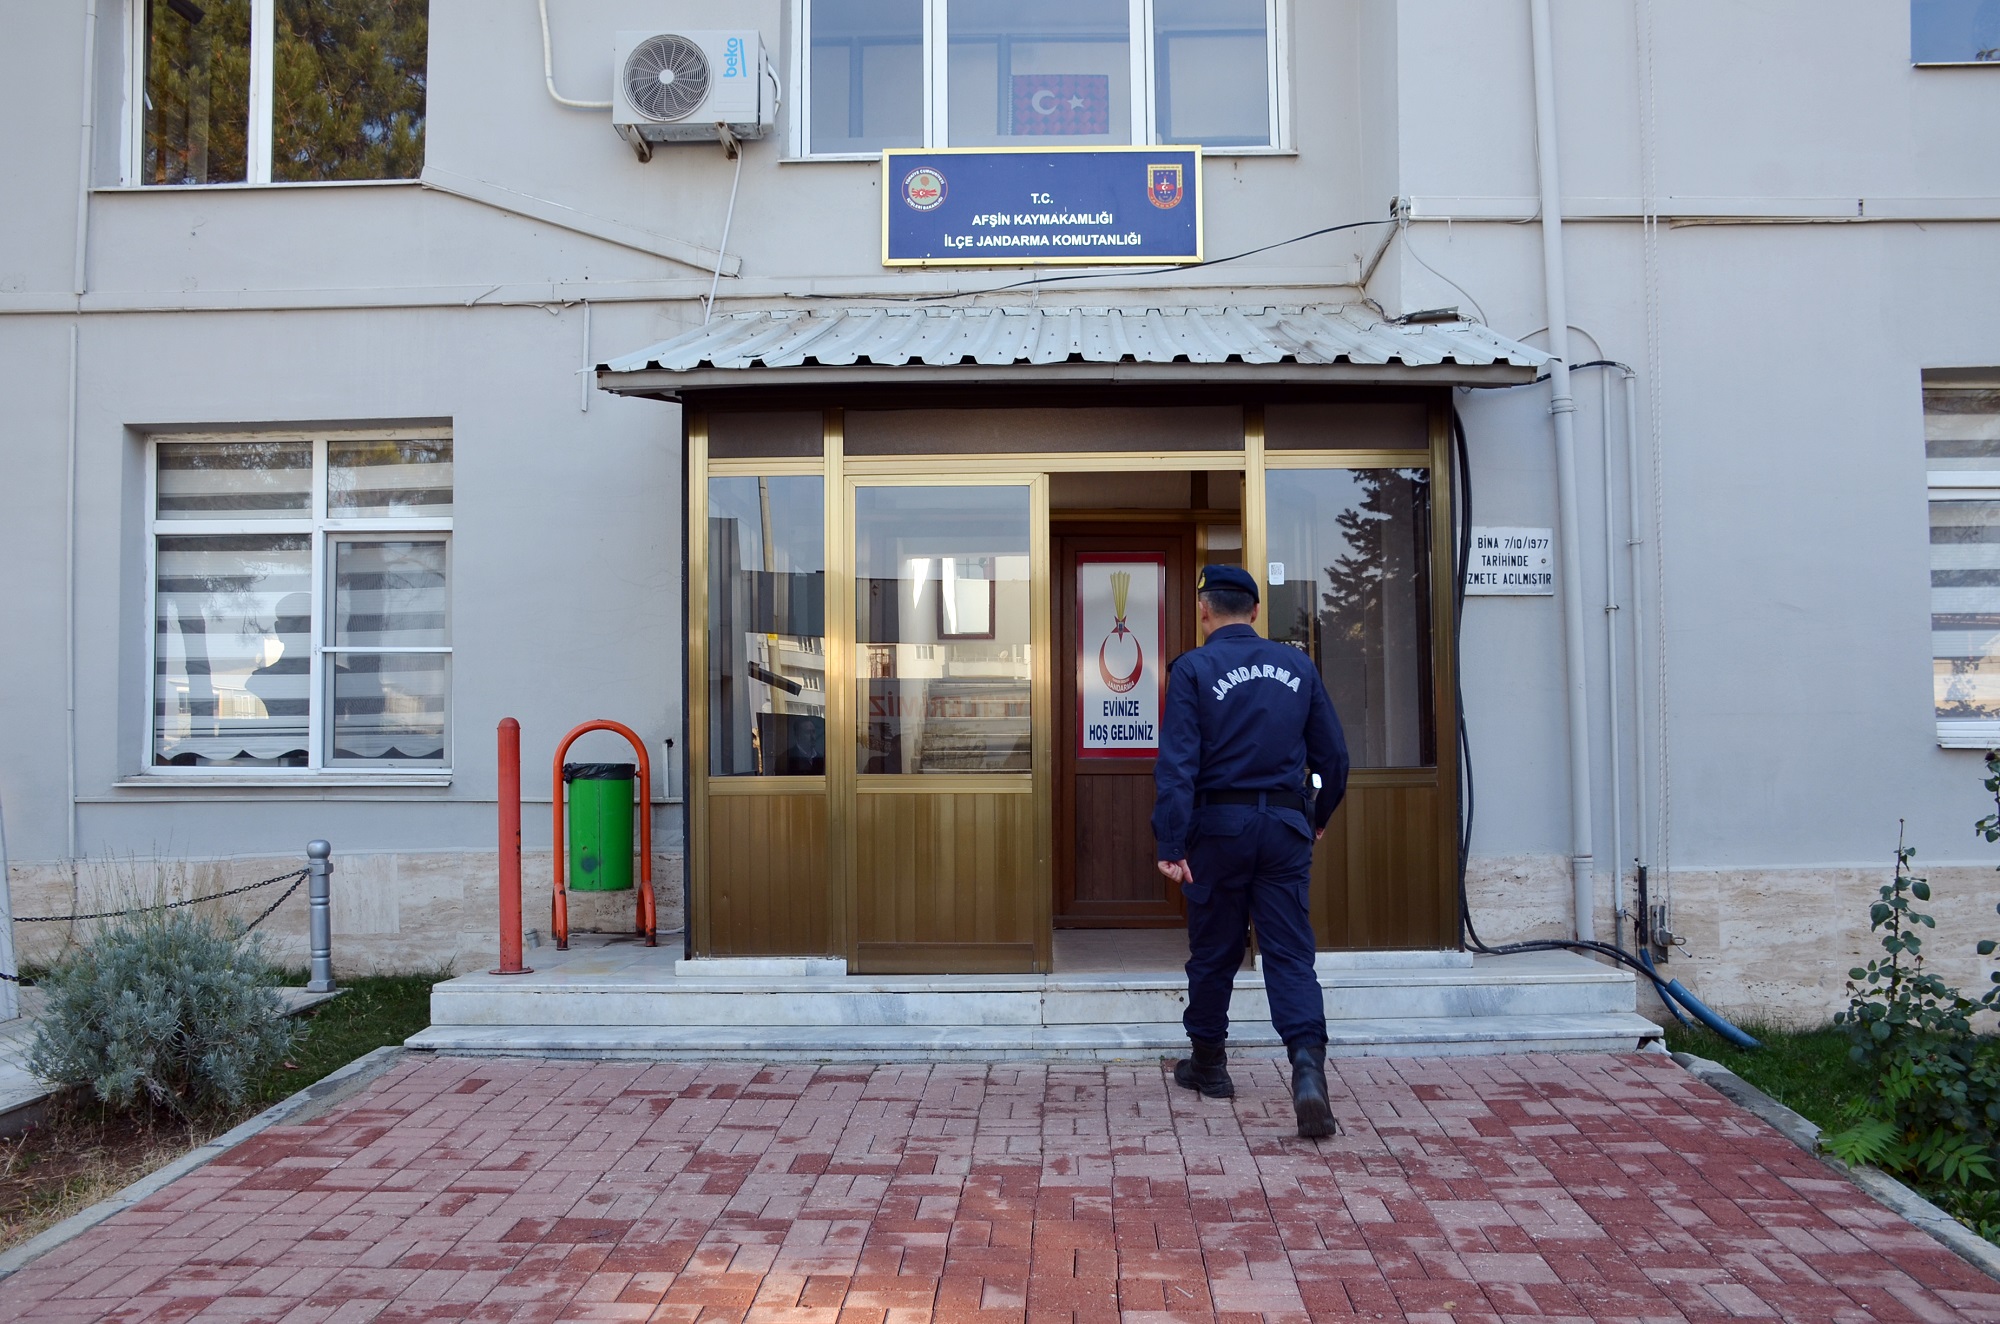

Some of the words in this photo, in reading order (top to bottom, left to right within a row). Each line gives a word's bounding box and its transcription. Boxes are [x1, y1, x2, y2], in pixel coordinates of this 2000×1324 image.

[723, 37, 739, 78] beko
[1030, 193, 1054, 204] T.C.
[972, 212, 1011, 228] AFŞİN
[1013, 211, 1113, 225] KAYMAKAMLIĞI
[944, 233, 973, 249] İLÇE
[976, 233, 1049, 247] JANDARMA
[1052, 231, 1142, 246] KOMUTANLIĞI
[1477, 535, 1499, 549] BİNA
[1504, 536, 1549, 550] 7/10/1977
[1481, 552, 1529, 567] TARİHİNDE
[1466, 573, 1498, 585] ZMETE
[1502, 573, 1552, 586] AÇILMIŞTIR
[1107, 680, 1135, 692] JANDARMA
[1212, 664, 1301, 701] JANDARMA
[1103, 697, 1140, 717] EVİNİZE
[1089, 724, 1109, 745] HOŞ
[1110, 721, 1154, 741] GELDİNİZ
